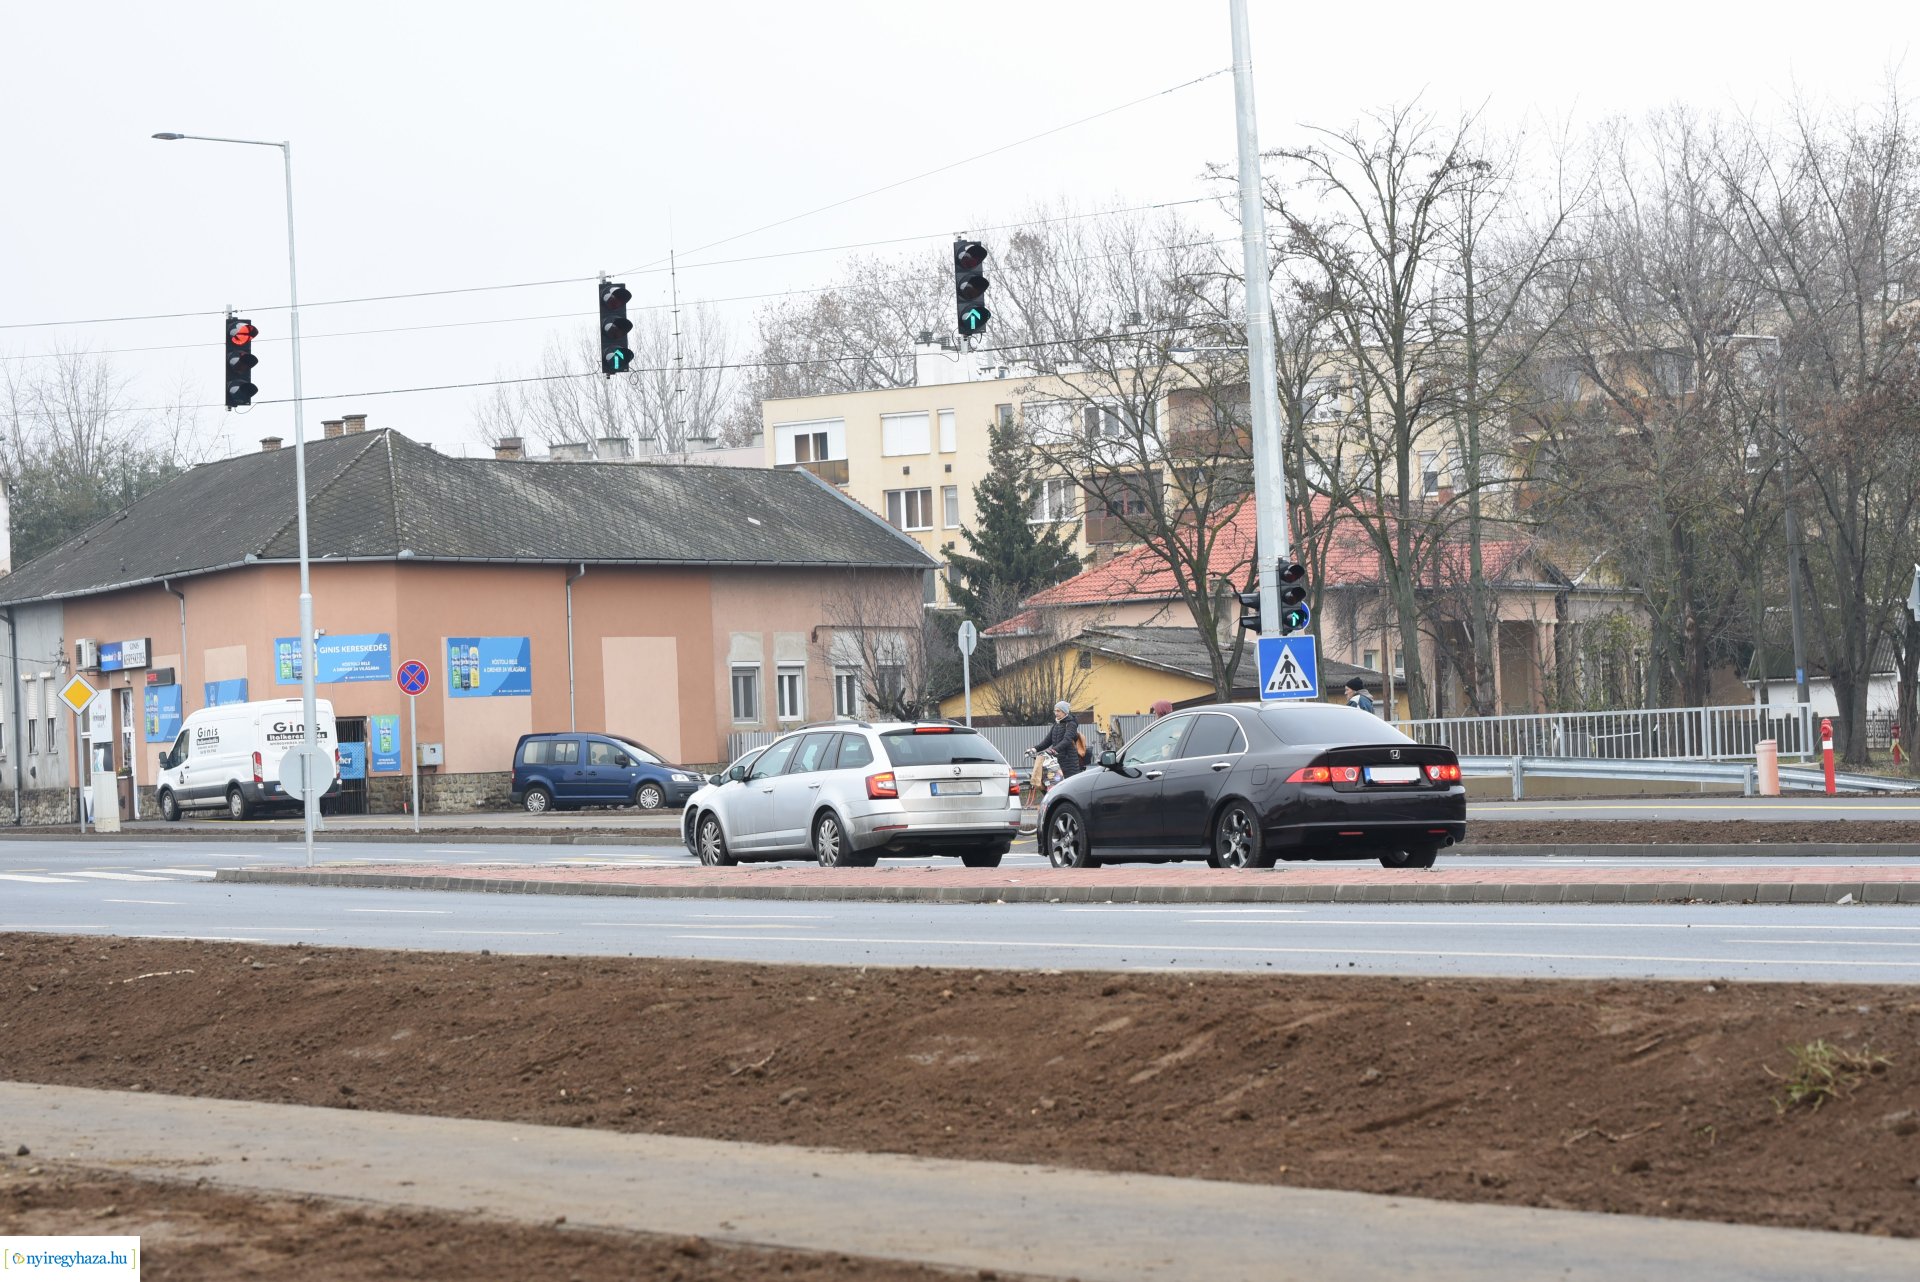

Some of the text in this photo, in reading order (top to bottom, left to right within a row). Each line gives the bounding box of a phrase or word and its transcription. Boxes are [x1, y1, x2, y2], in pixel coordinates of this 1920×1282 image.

[319, 643, 388, 654] GINIS KERESKEDÉS
[197, 726, 218, 738] Ginis
[273, 721, 321, 733] Gins
